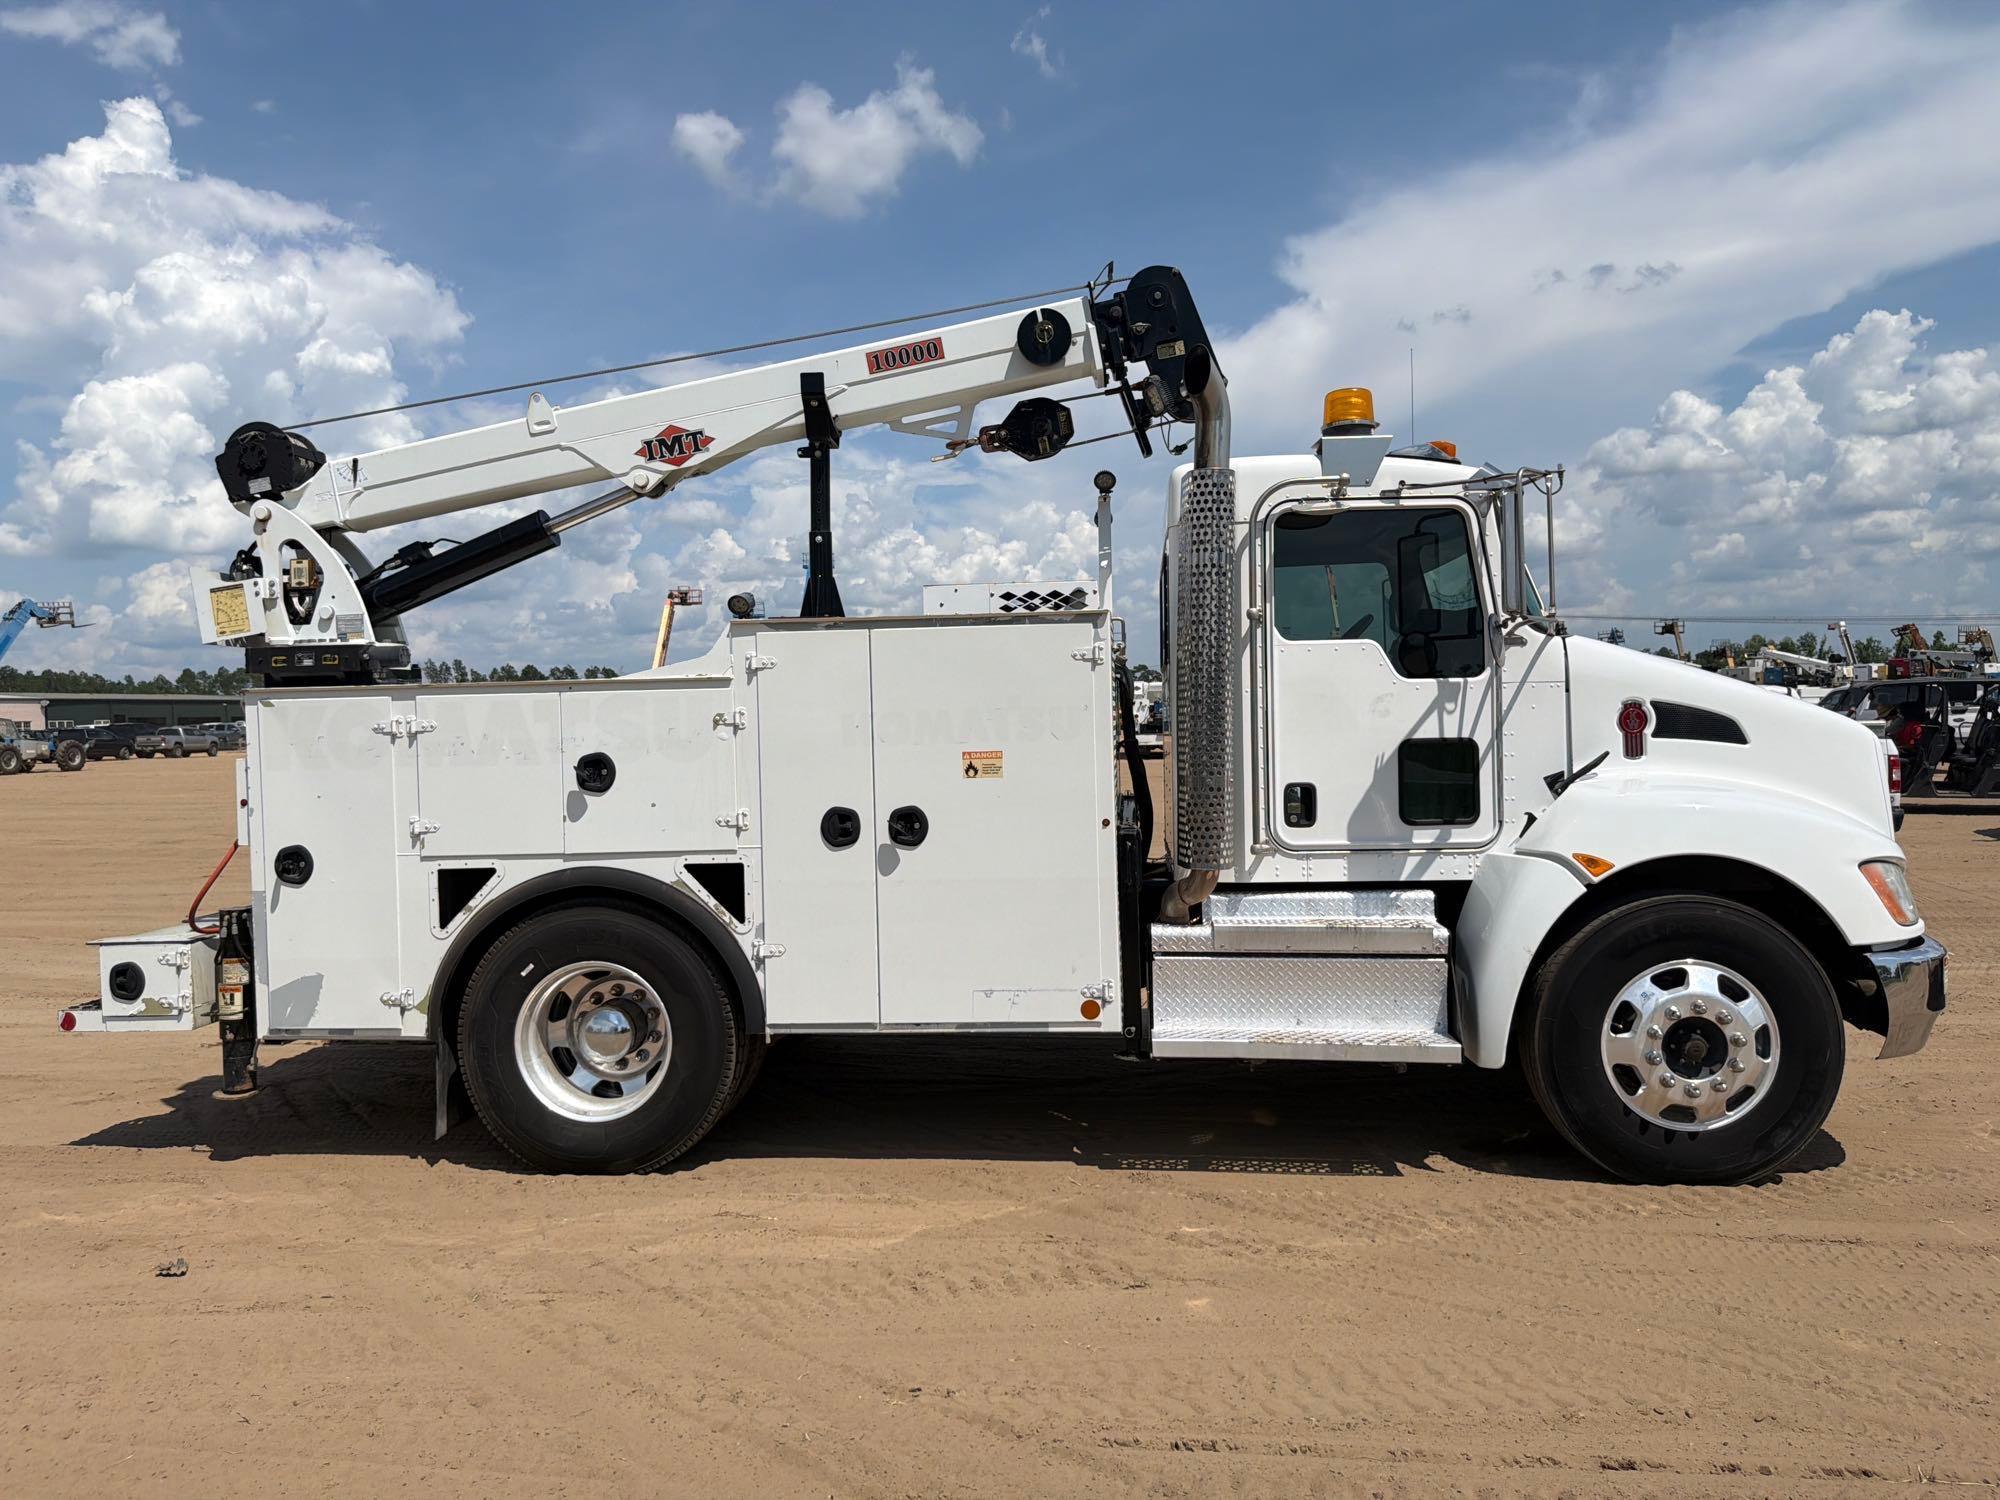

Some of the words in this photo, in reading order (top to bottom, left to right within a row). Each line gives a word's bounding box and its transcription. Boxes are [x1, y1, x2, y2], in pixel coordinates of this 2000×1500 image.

[872, 340, 939, 371] 10000
[642, 429, 705, 462] IMT
[970, 751, 1002, 760] DANGER
